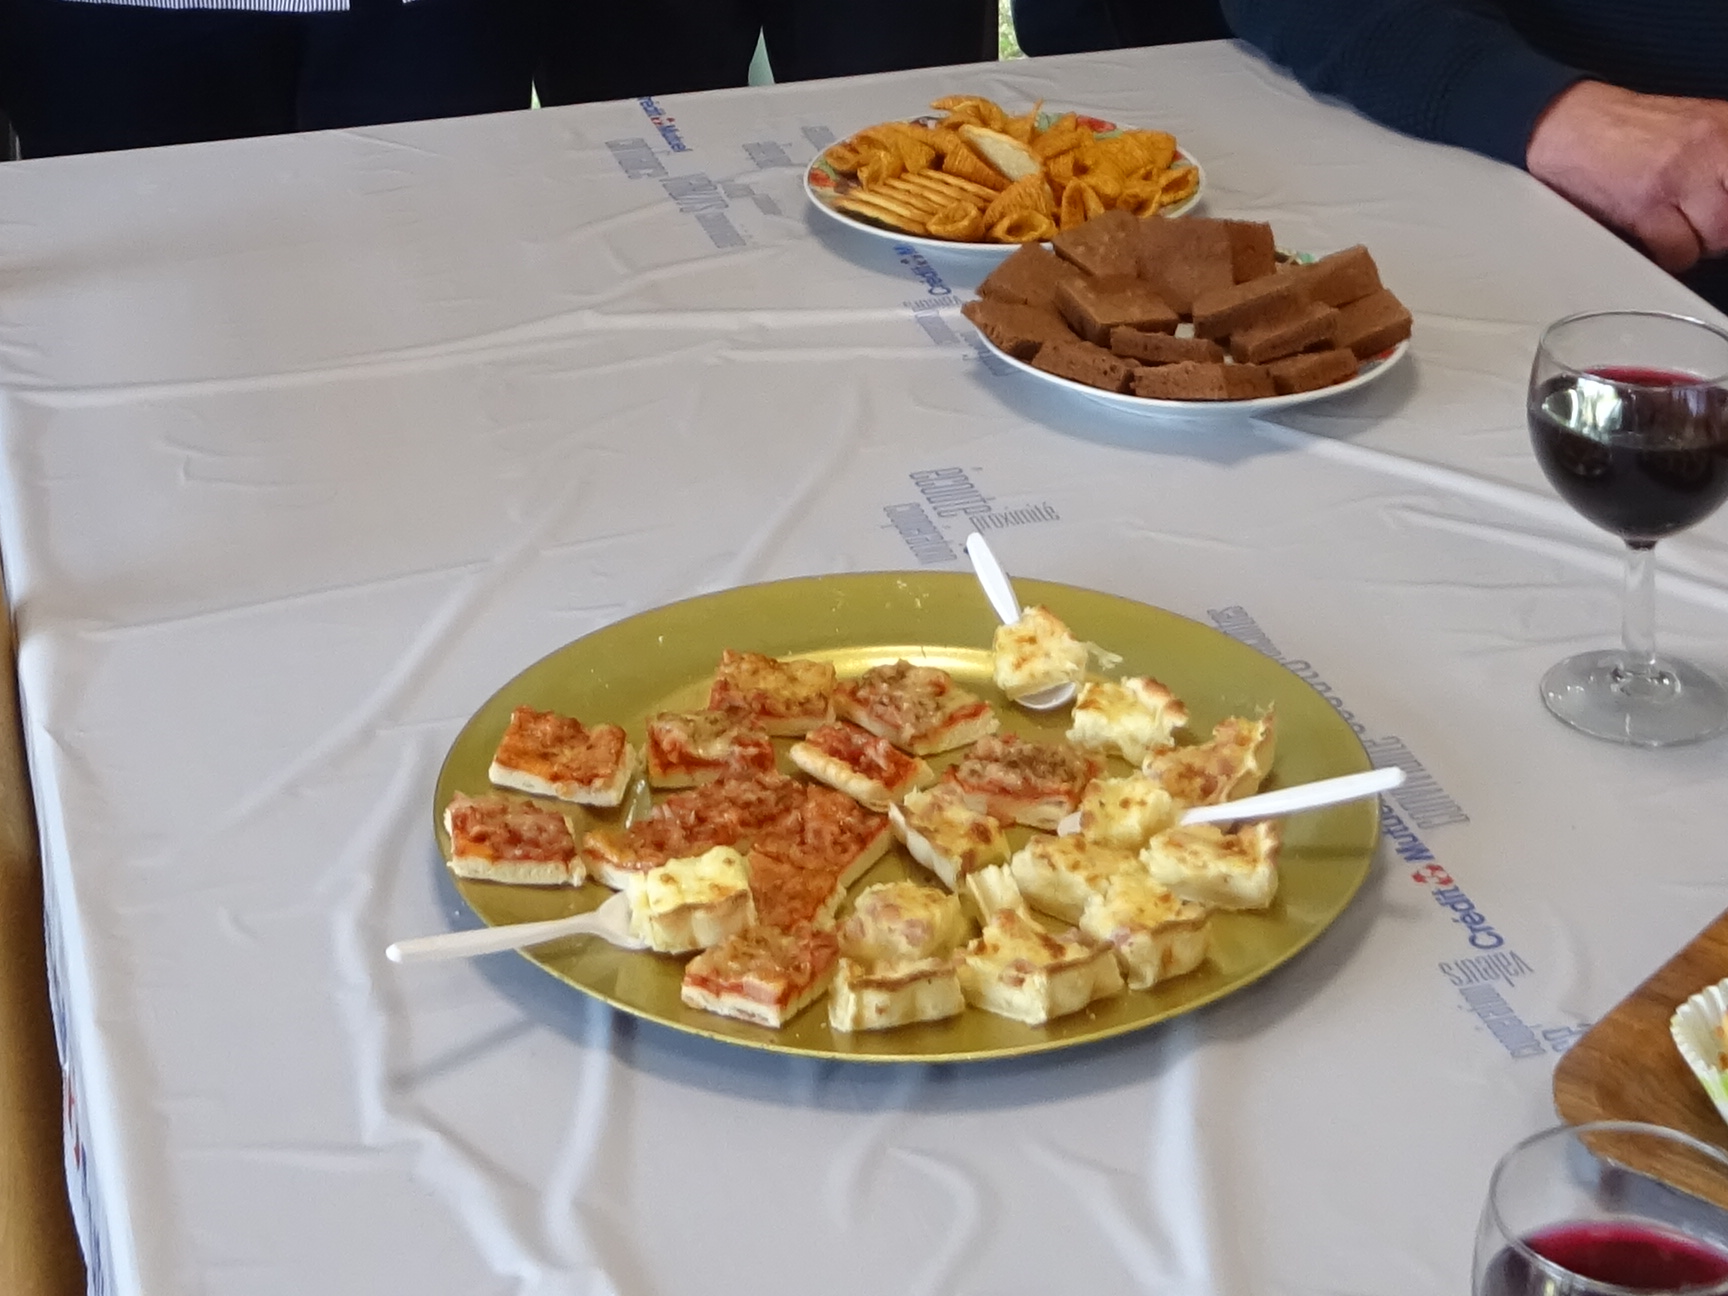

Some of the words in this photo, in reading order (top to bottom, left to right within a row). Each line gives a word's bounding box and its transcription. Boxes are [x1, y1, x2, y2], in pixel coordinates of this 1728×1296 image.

[970, 500, 1061, 536] proximité
[1432, 885, 1504, 949] Crédit
[1438, 950, 1534, 988] valeurs
